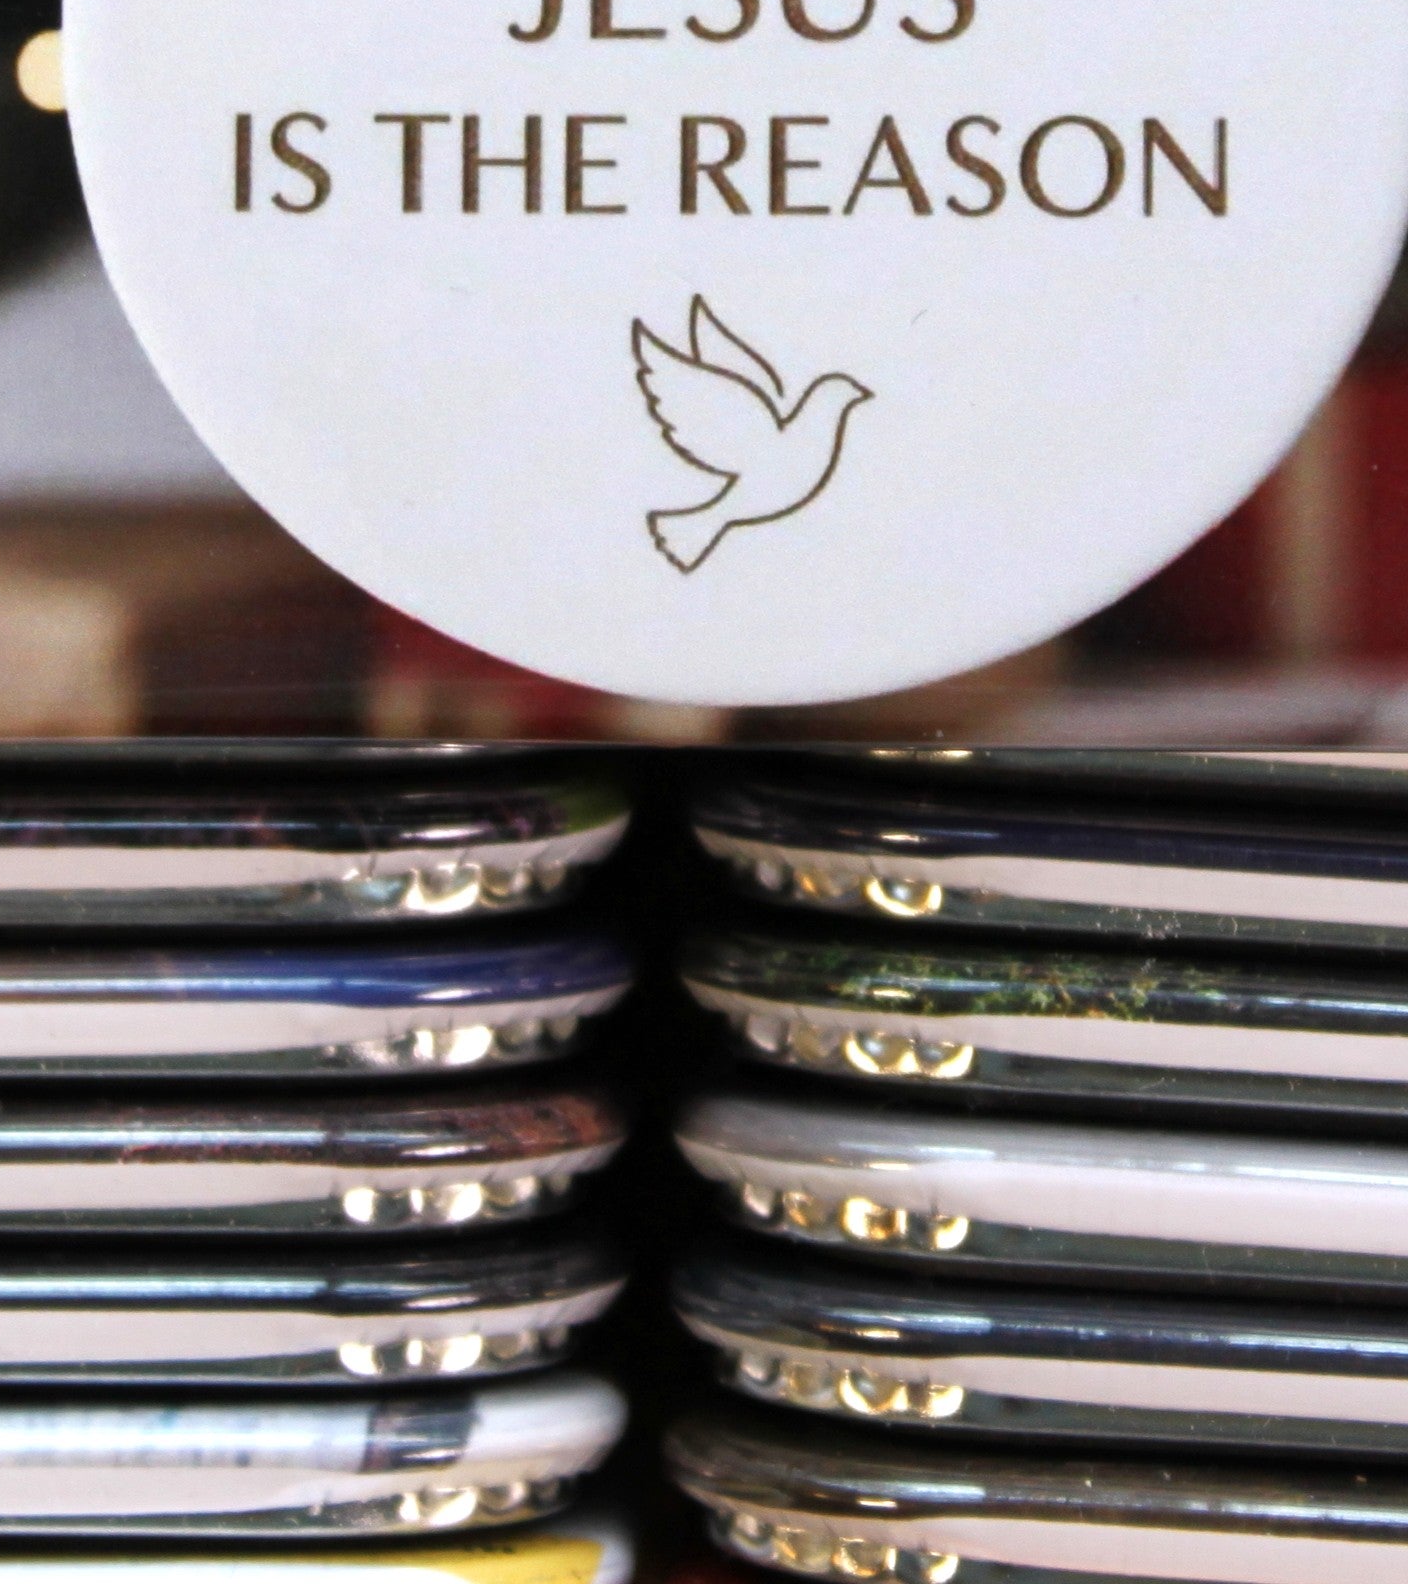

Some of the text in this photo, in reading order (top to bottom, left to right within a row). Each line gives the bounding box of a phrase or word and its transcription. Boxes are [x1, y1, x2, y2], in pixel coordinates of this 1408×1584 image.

[235, 112, 1226, 217] IS THE REASON
